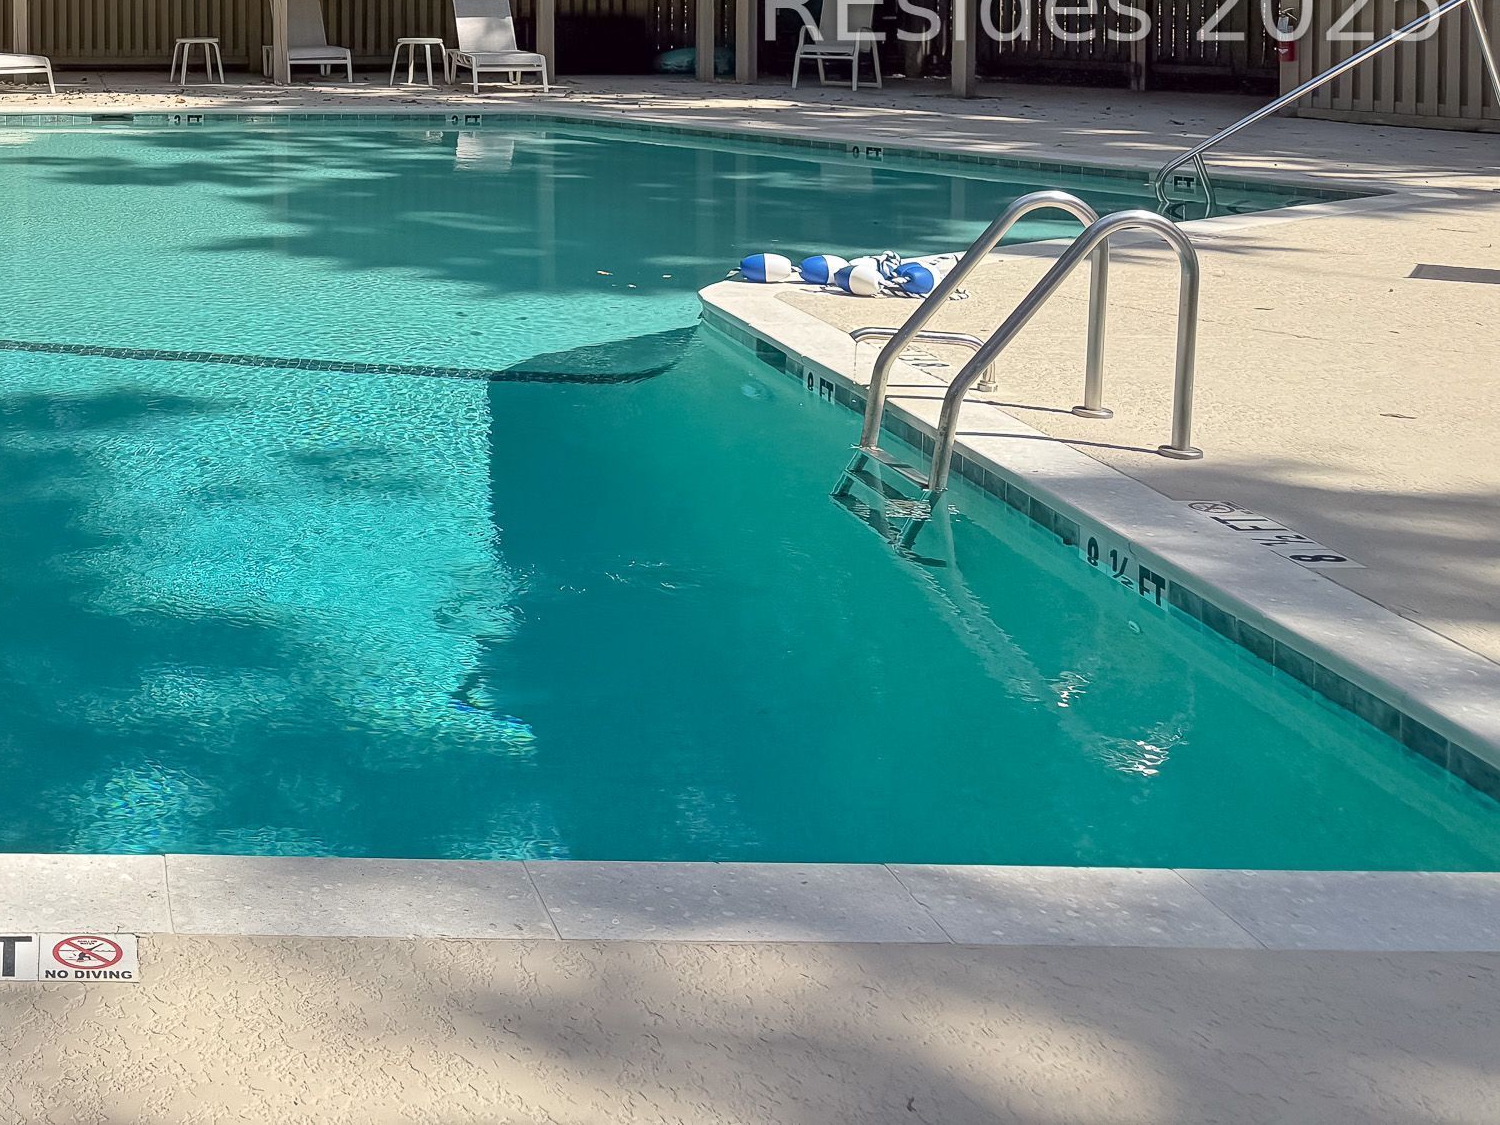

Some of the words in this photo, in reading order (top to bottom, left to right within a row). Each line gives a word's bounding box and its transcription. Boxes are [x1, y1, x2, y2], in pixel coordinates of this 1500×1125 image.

[1139, 564, 1166, 607] FT
[45, 969, 69, 979] NO
[74, 970, 133, 979] DIVING
